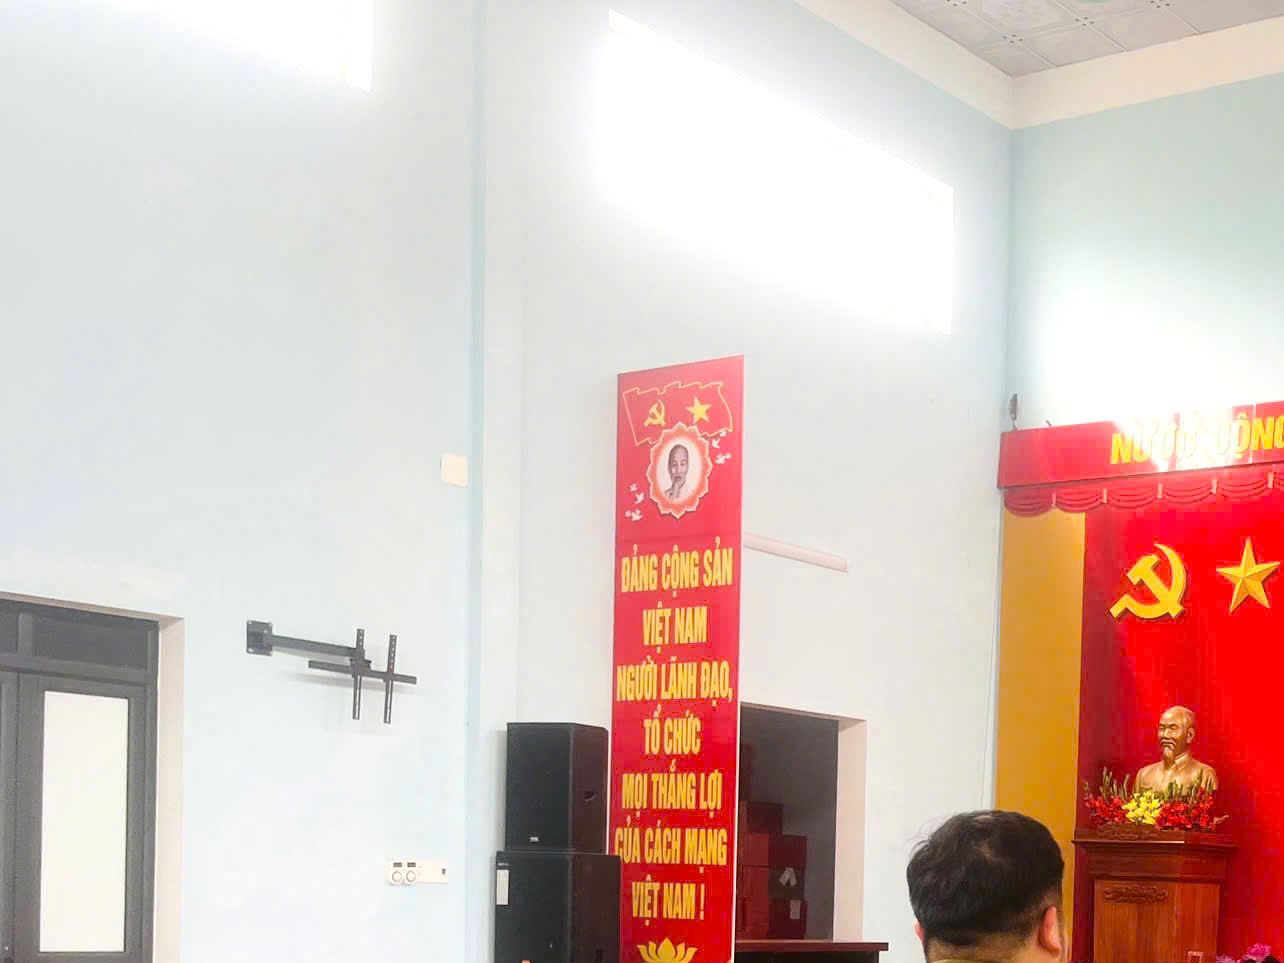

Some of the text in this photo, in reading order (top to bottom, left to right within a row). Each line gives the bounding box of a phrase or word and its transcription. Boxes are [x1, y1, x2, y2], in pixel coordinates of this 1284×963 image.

[621, 537, 733, 597] ĐẢNG CỘNG SẢN
[643, 602, 708, 654] VIỆT NAM
[616, 655, 733, 706] NGƯỜI LÃNH ĐẠO,
[644, 704, 701, 755] TỔ CHỨC
[622, 759, 722, 818] MỌI THẮNG LỢI
[614, 816, 727, 873] CỦA CÁCH MẠNG
[632, 874, 705, 926] VIỆT NAM !
